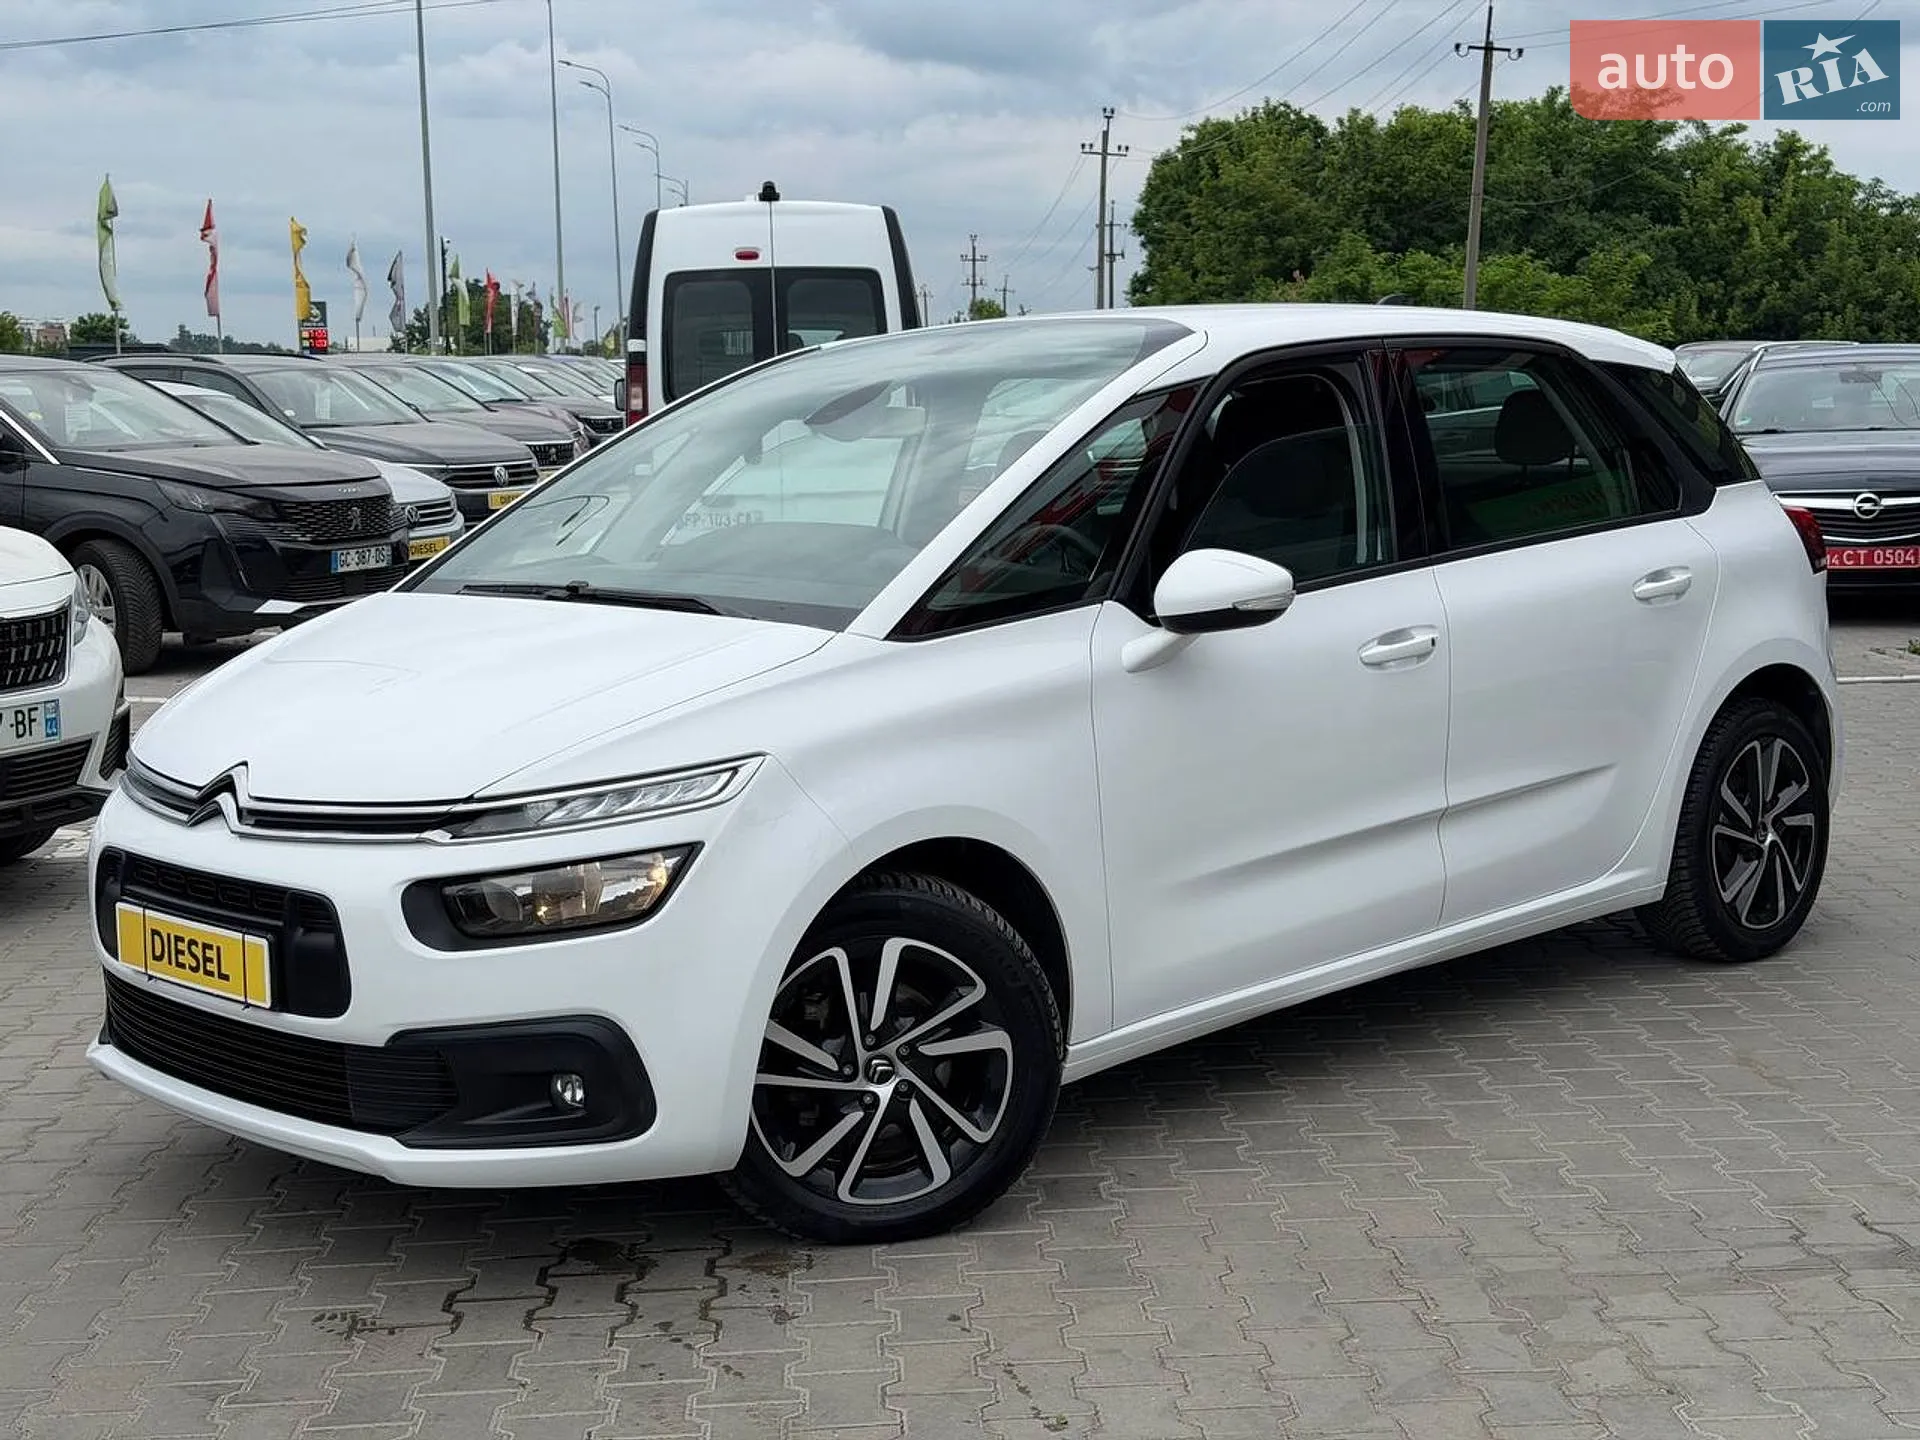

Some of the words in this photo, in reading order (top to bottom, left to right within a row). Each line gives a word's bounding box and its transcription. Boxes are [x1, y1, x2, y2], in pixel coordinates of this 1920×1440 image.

[410, 543, 438, 556] DIESEL
[1843, 550, 1868, 565] CT
[1873, 549, 1915, 565] 0504
[0, 706, 39, 739] -BF
[151, 928, 230, 982] DIESEL
